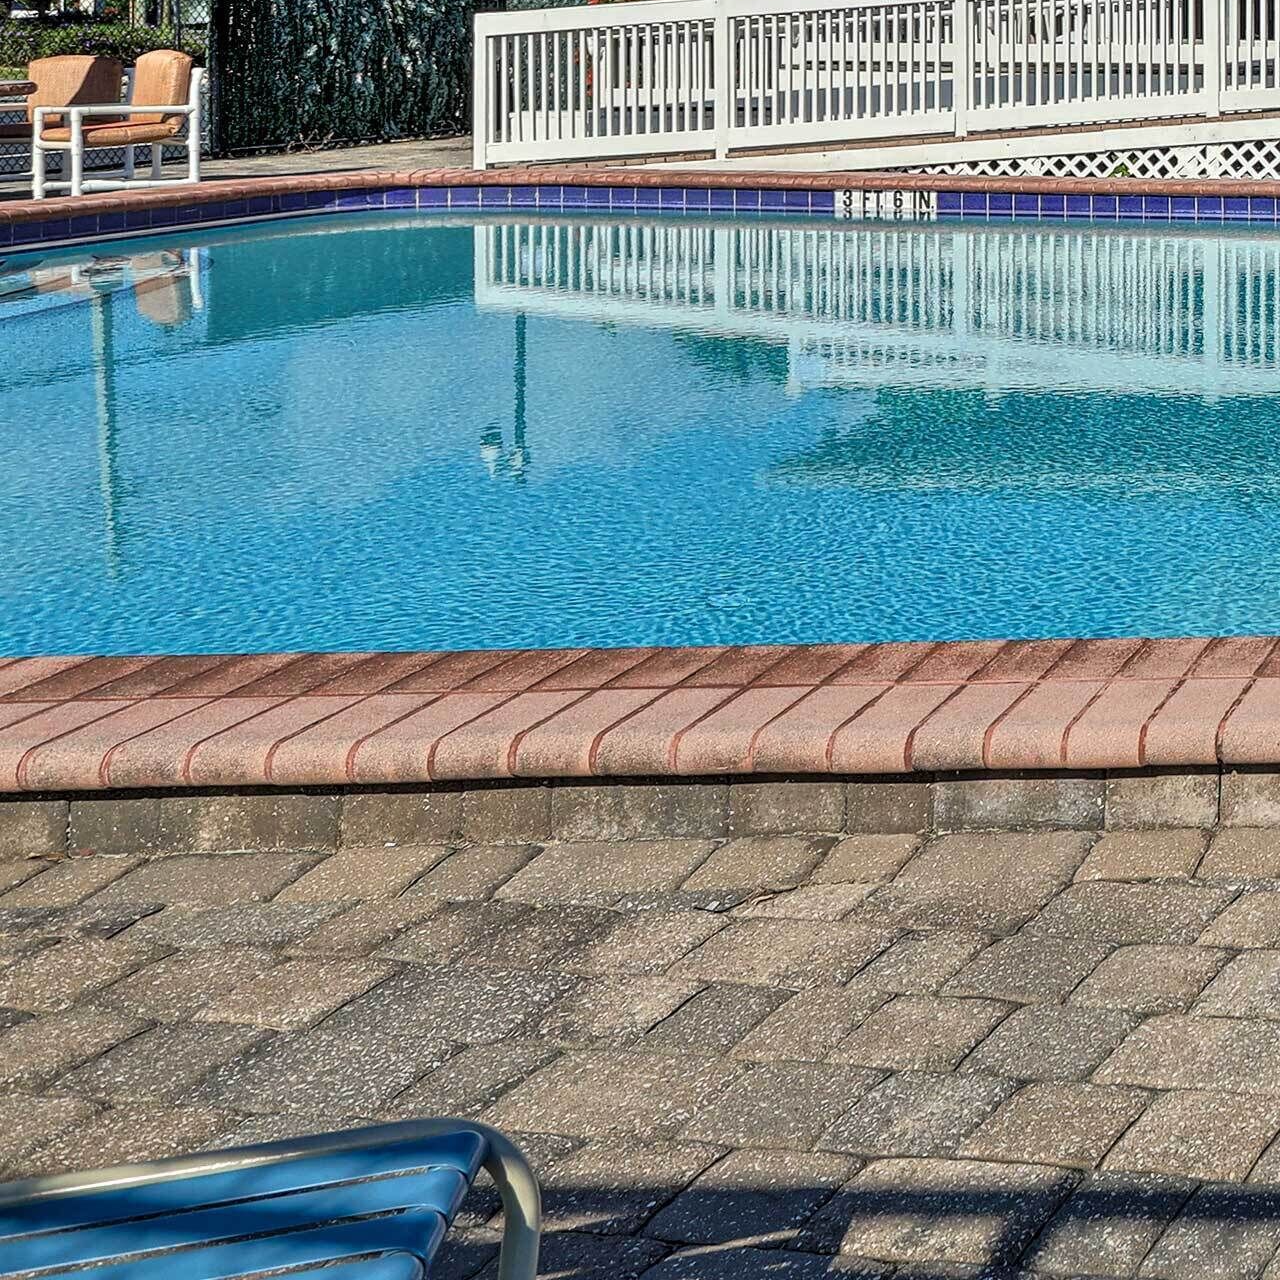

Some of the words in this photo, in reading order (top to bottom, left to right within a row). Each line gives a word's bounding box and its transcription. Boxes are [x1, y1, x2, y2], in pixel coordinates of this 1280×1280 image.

[842, 189, 853, 208] 3
[862, 190, 883, 210] FT.
[893, 190, 903, 209] 6
[913, 190, 934, 209] IN.
